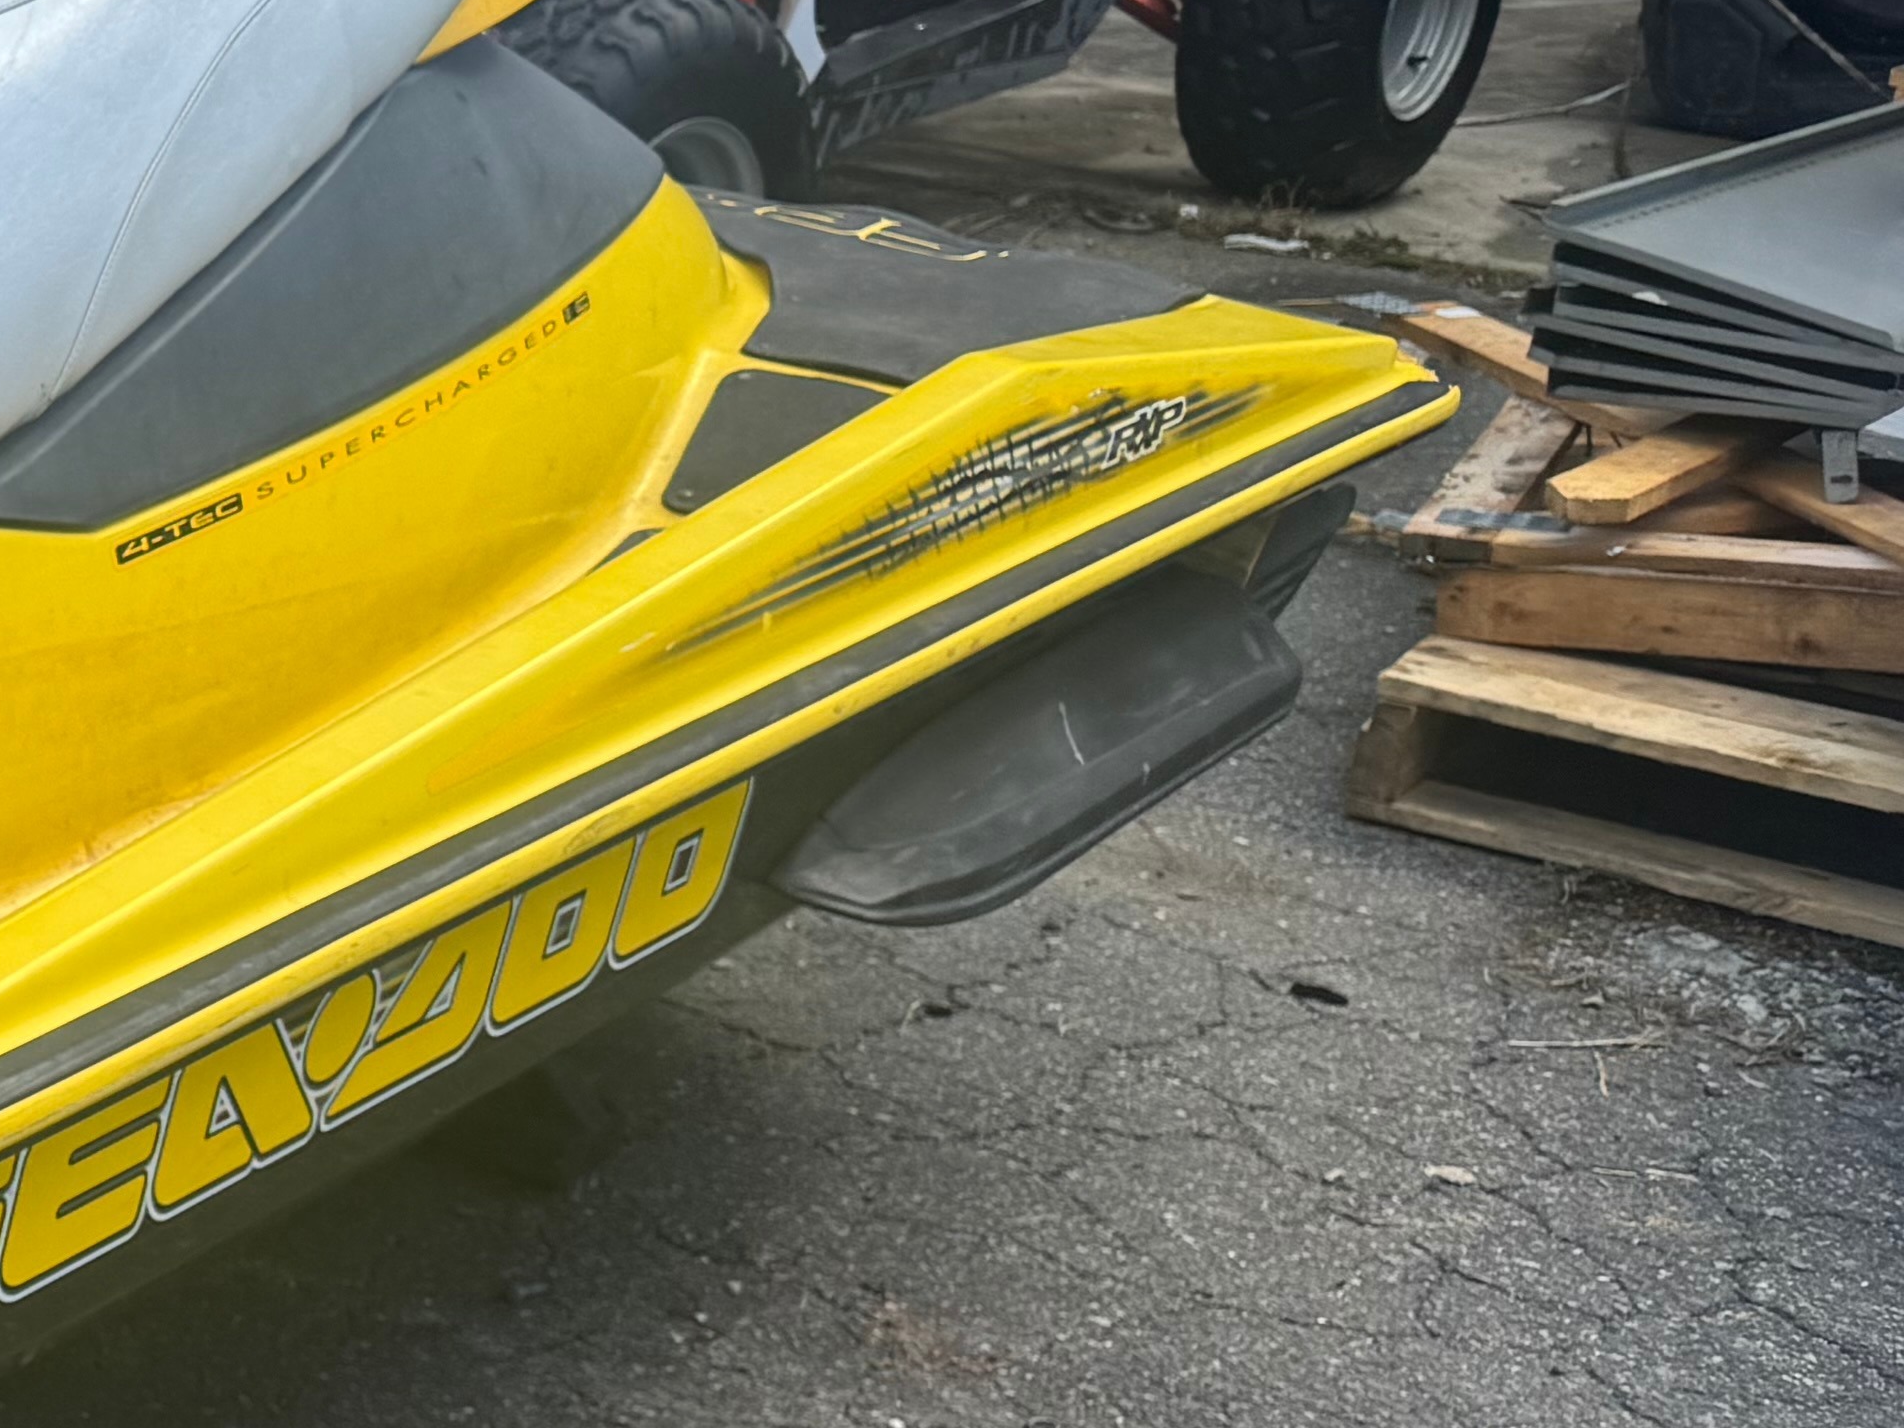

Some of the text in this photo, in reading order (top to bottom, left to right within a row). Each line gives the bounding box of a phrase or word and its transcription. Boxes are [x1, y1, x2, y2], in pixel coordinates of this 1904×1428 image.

[119, 496, 242, 560] 4-TEC
[256, 320, 557, 500] SUPERCHARGED
[1102, 396, 1186, 468] RXP
